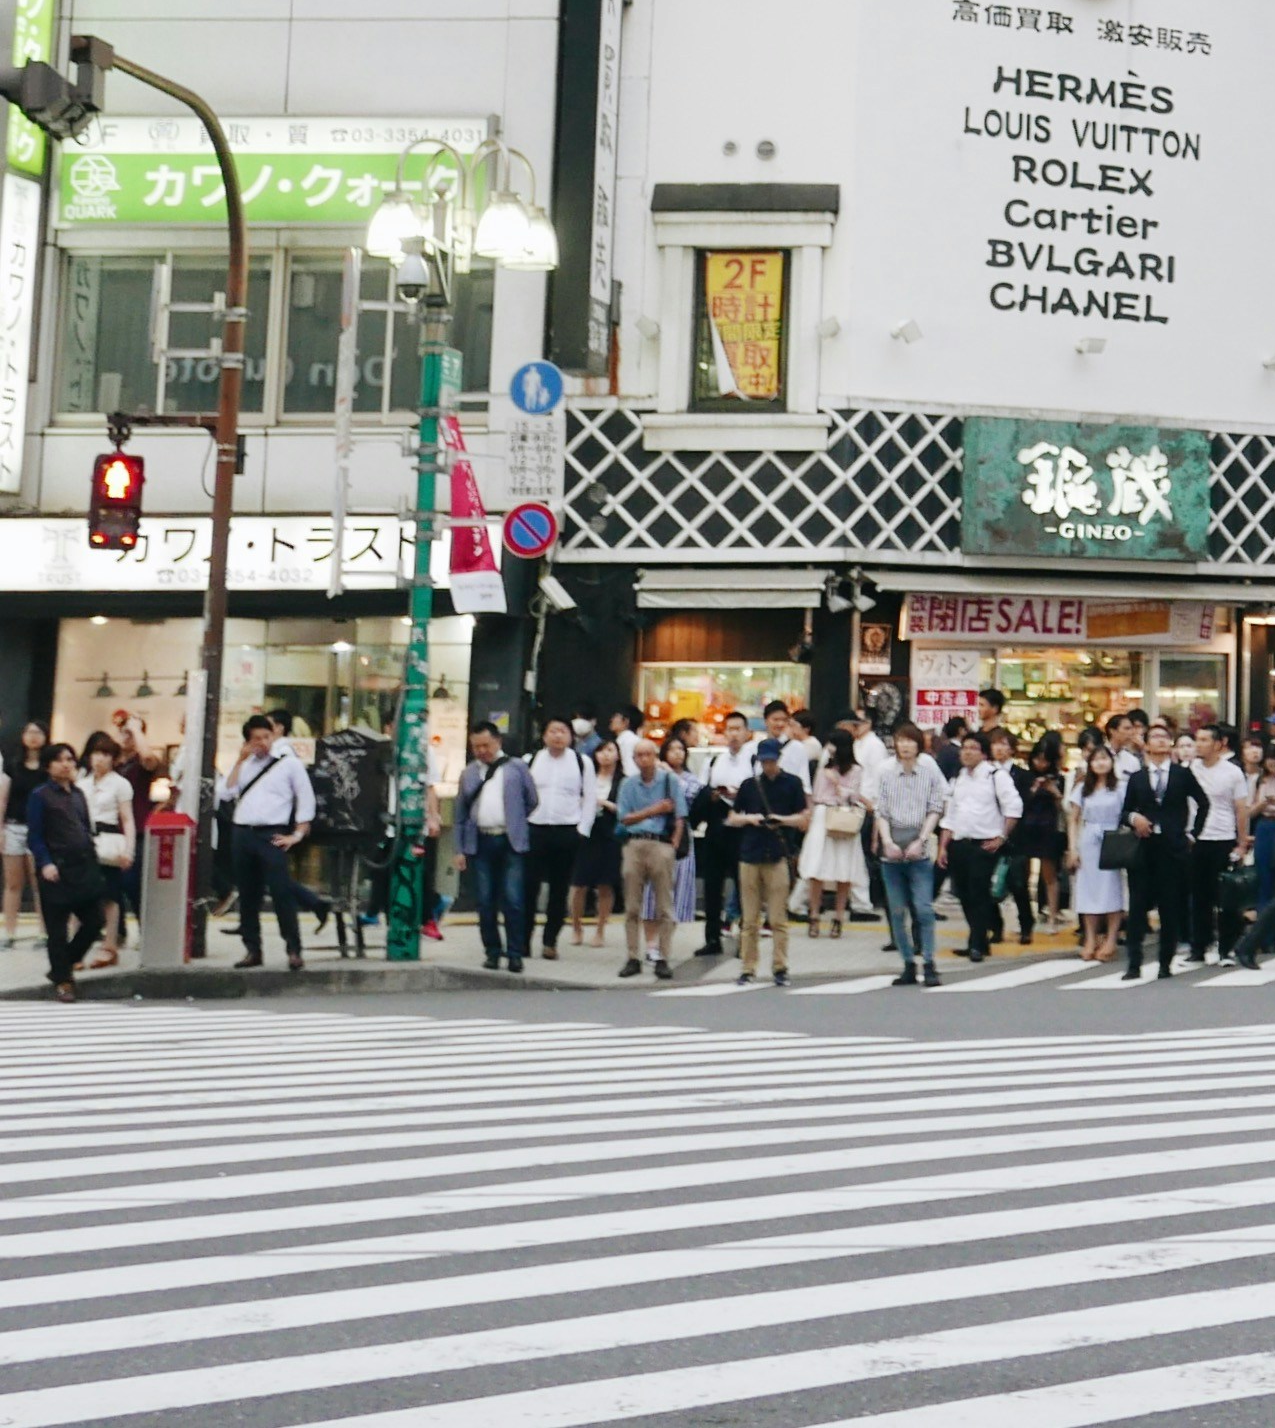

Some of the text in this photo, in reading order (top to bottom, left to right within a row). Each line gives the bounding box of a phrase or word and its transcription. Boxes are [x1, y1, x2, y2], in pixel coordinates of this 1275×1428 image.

[1097, 18, 1213, 55] 激安販売
[993, 65, 1175, 114] HERMÈS
[964, 107, 1200, 161] LOUIS VUITTON
[1012, 155, 1154, 197] ROLEX
[64, 204, 117, 220] QUARK
[1003, 199, 1159, 240] Cartier
[724, 259, 766, 289] 2F
[986, 239, 1176, 283] BVLGARI
[712, 294, 774, 324] 時計
[990, 283, 1170, 325] CHANEL
[1017, 441, 1173, 526] 銀蔵
[116, 527, 418, 562] カワ・トラスト
[38, 574, 81, 585] TRUST
[919, 651, 977, 675] ヴィトン
[924, 691, 969, 705] 中古品
